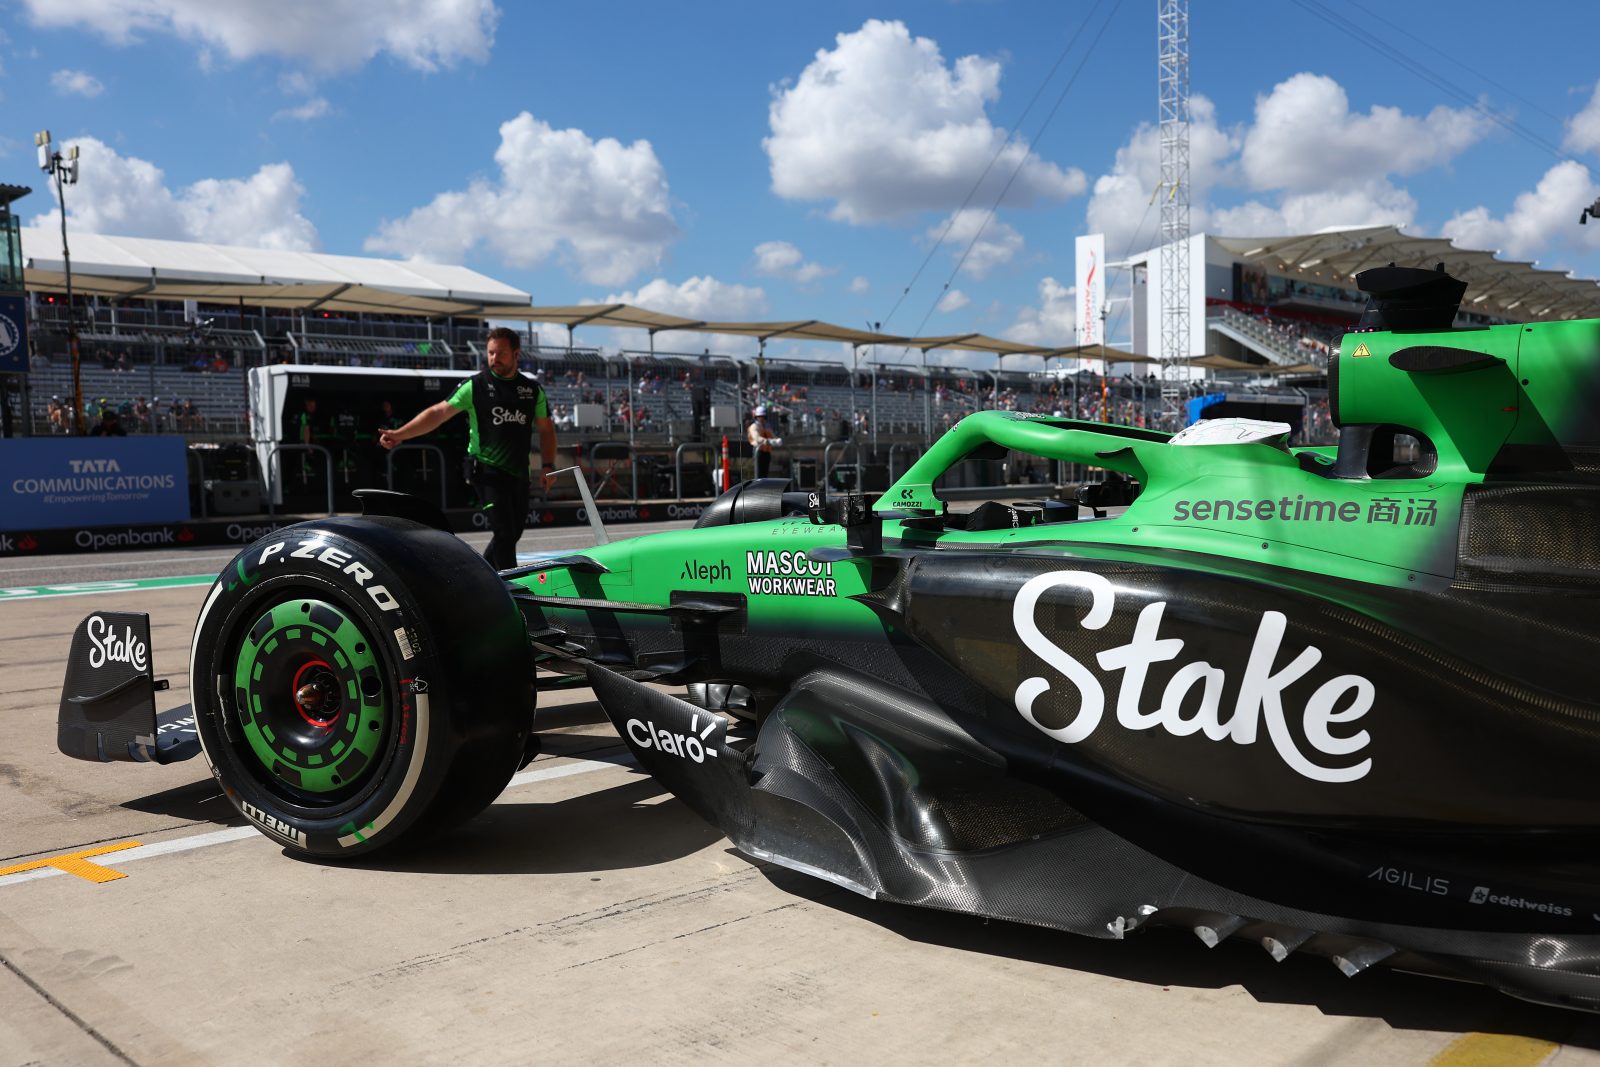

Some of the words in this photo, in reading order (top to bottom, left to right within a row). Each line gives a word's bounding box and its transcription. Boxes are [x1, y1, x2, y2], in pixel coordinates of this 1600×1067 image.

[491, 406, 526, 425] Stake
[69, 459, 120, 473] TATA
[12, 474, 175, 494] COMMUNICATIONS
[1173, 494, 1361, 522] sensetime
[1367, 497, 1438, 527] 商汤
[75, 527, 175, 550] Openbank
[680, 559, 731, 584] Aleph
[747, 576, 837, 597] WORKWEAR
[87, 615, 147, 671] Stake
[1012, 570, 1376, 783] Stake
[626, 718, 705, 764] Claro
[1367, 866, 1450, 896] AGILIS
[1488, 893, 1573, 917] edelweiss
